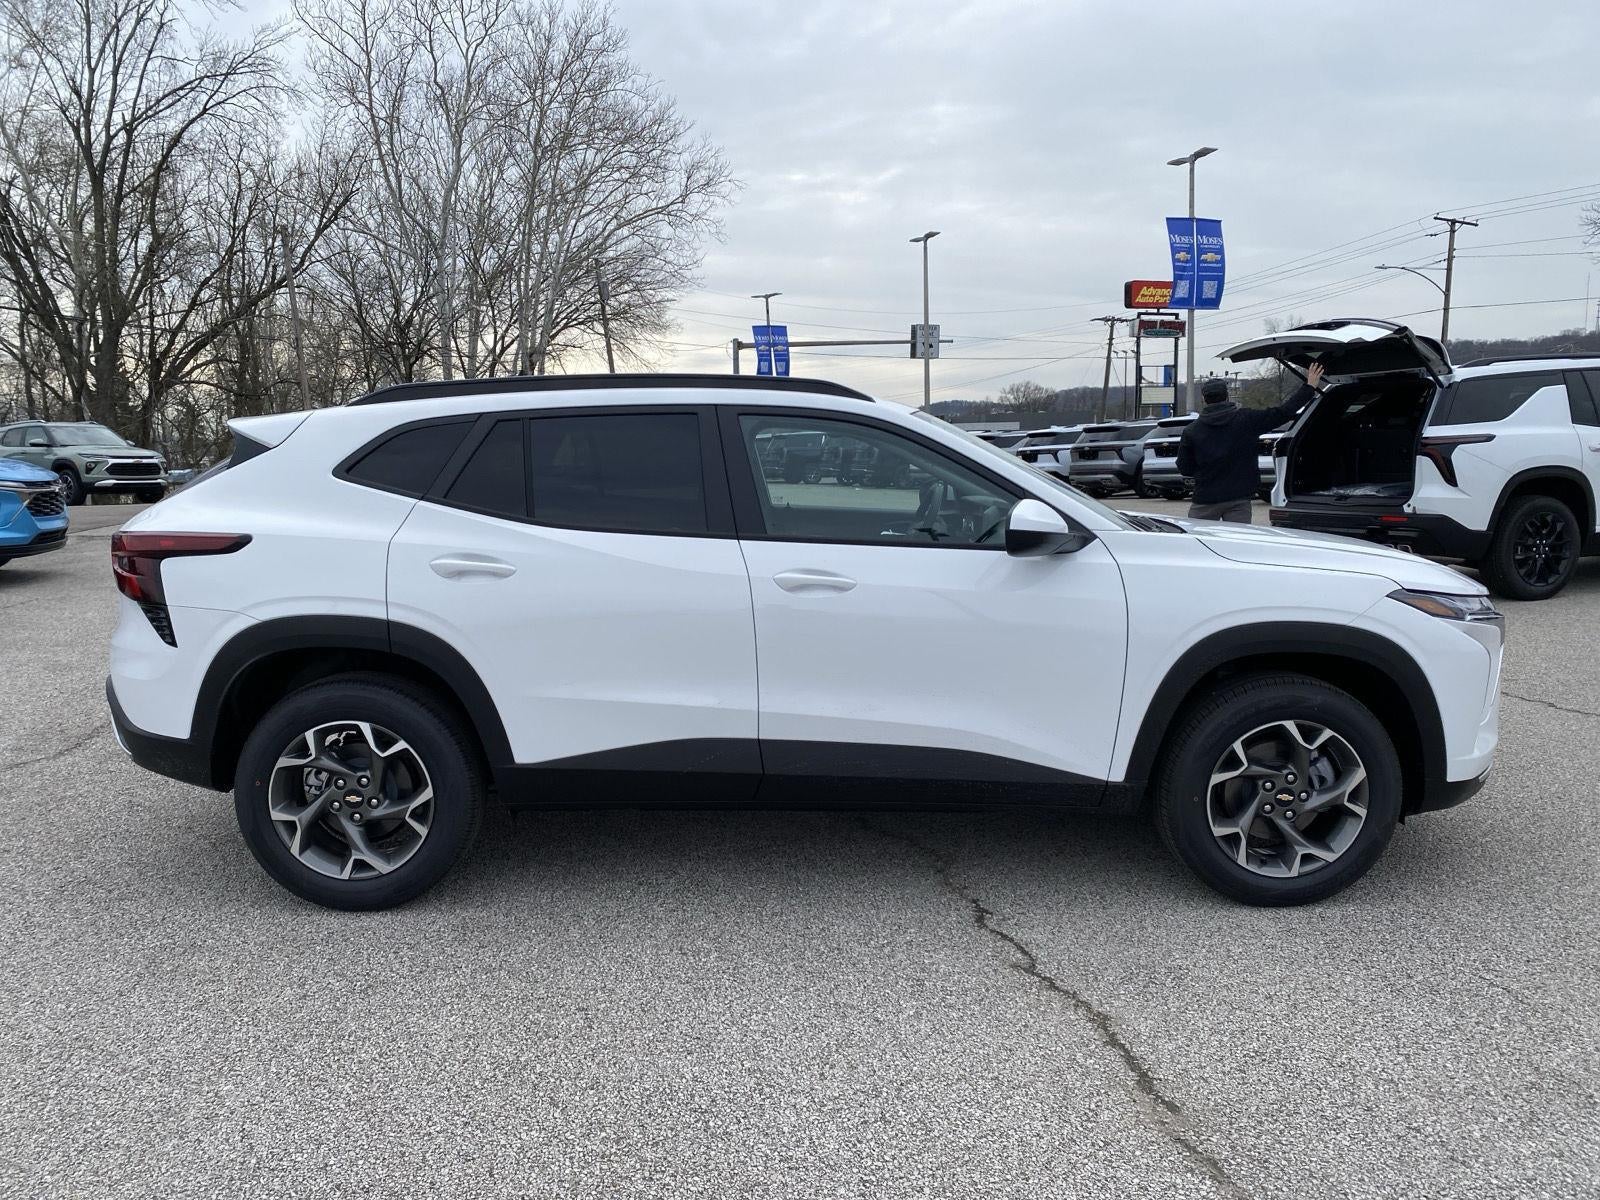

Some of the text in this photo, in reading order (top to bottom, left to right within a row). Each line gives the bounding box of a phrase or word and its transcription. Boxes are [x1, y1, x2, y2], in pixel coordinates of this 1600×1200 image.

[1170, 234, 1193, 244] MOSES
[1197, 235, 1223, 246] MOSES
[1140, 286, 1172, 295] Advanc
[1136, 295, 1170, 303] Auto Part
